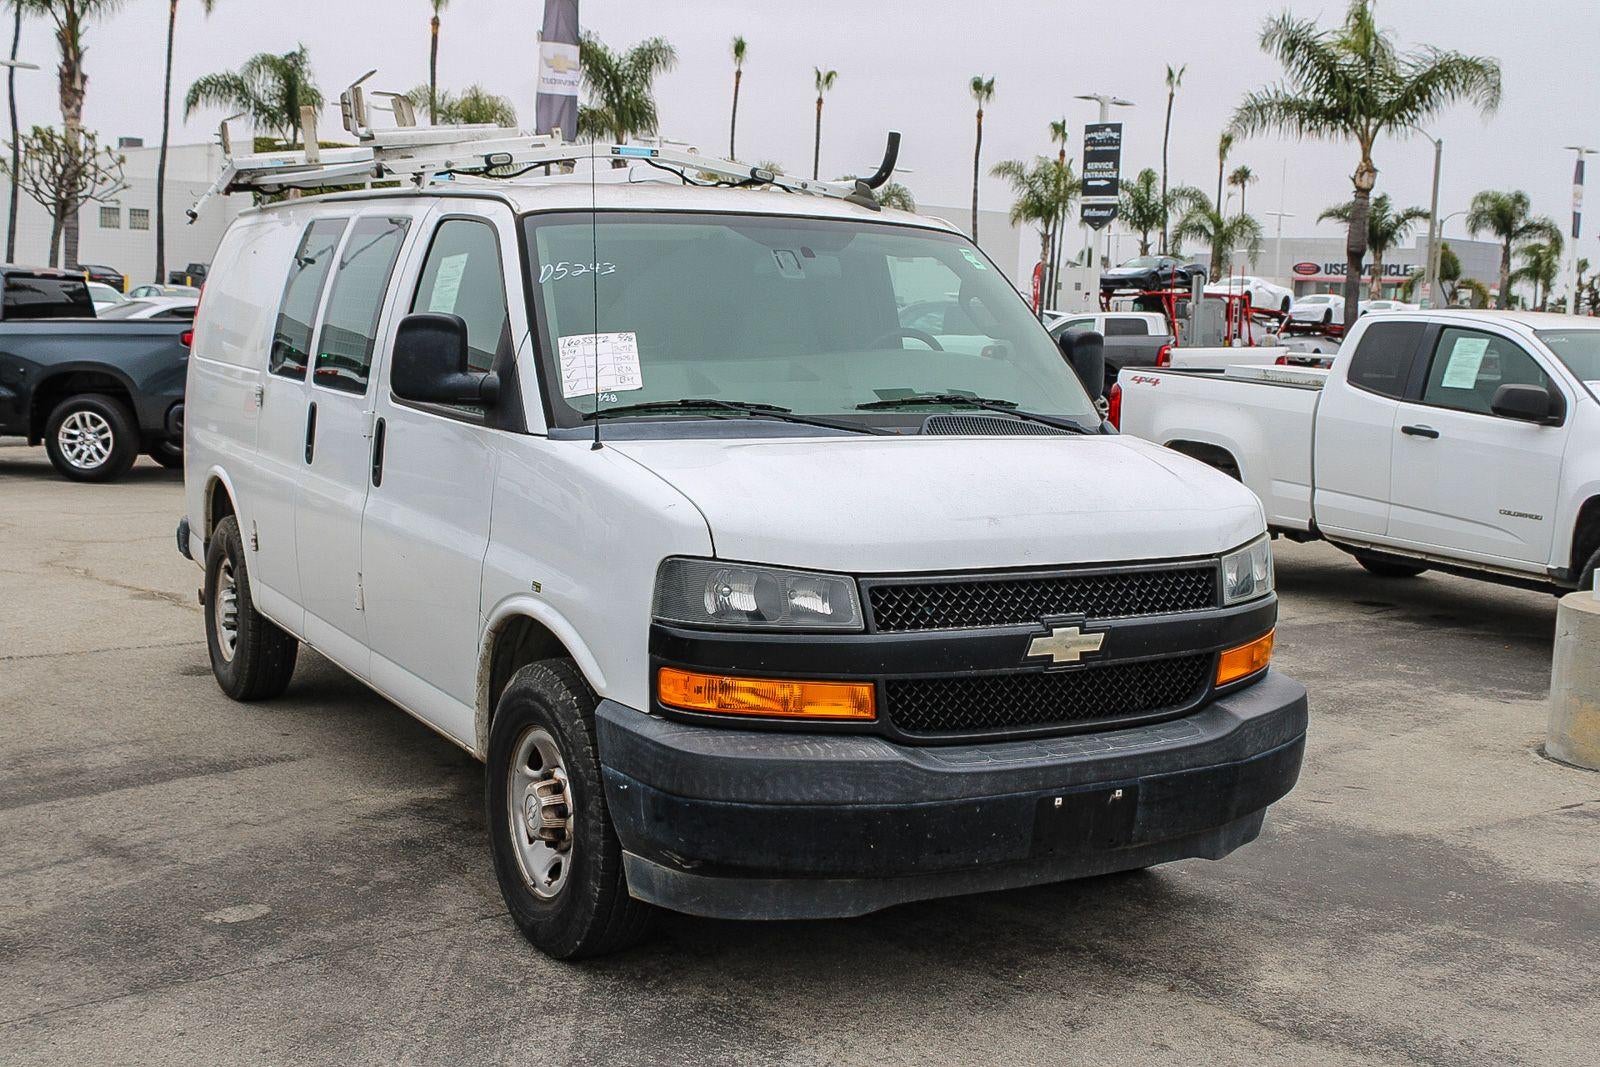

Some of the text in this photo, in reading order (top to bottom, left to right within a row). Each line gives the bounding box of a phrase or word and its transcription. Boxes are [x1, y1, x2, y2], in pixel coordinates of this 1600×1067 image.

[1324, 263, 1415, 276] USE VEICLE
[1499, 509, 1543, 520] COLORADO
